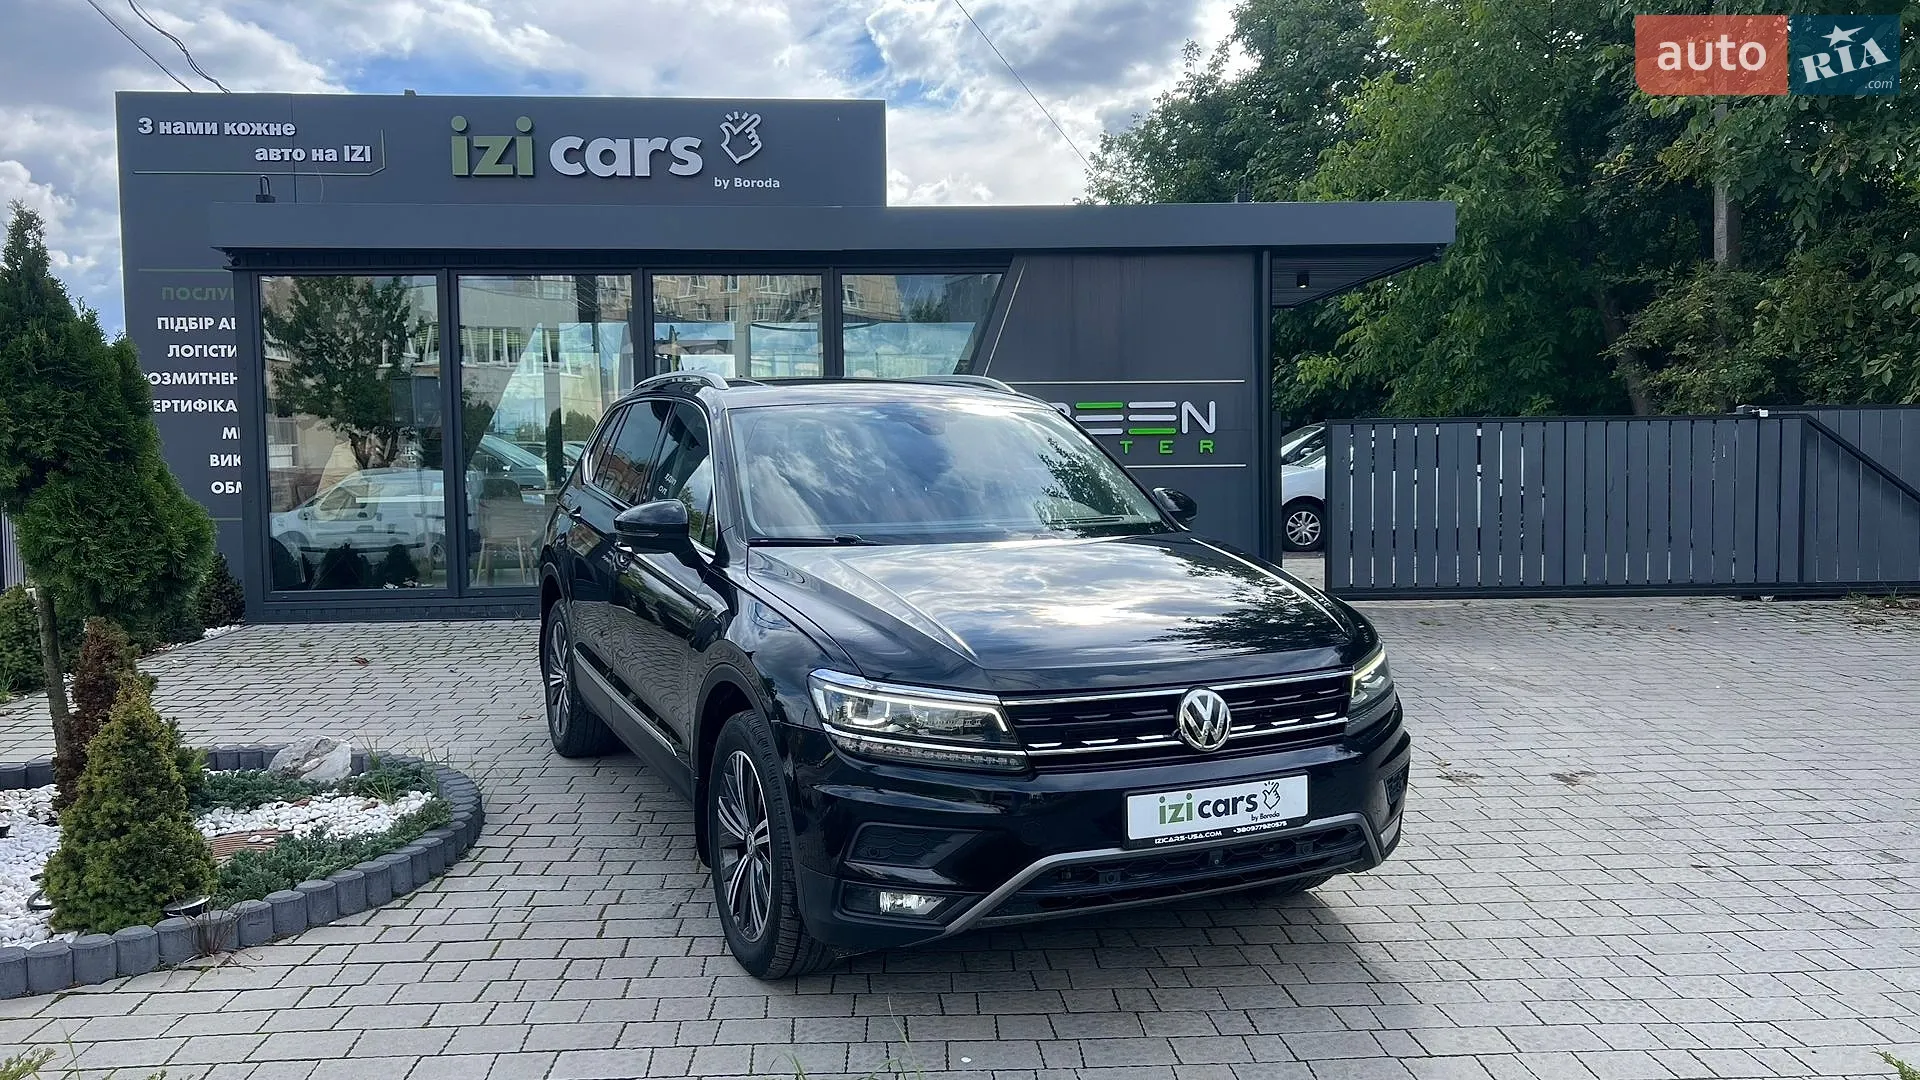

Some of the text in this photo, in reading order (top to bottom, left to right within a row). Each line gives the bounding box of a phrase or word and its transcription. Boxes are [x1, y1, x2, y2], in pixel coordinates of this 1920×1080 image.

[138, 117, 296, 136] З нами кожне
[255, 145, 372, 162] авто на IZI
[451, 115, 704, 177] izi cars
[714, 176, 781, 190] by Boroda
[157, 316, 215, 332] ПІДБІР
[1051, 400, 1216, 434] EEN
[1159, 792, 1258, 824] izi cars
[1251, 813, 1259, 822] by
